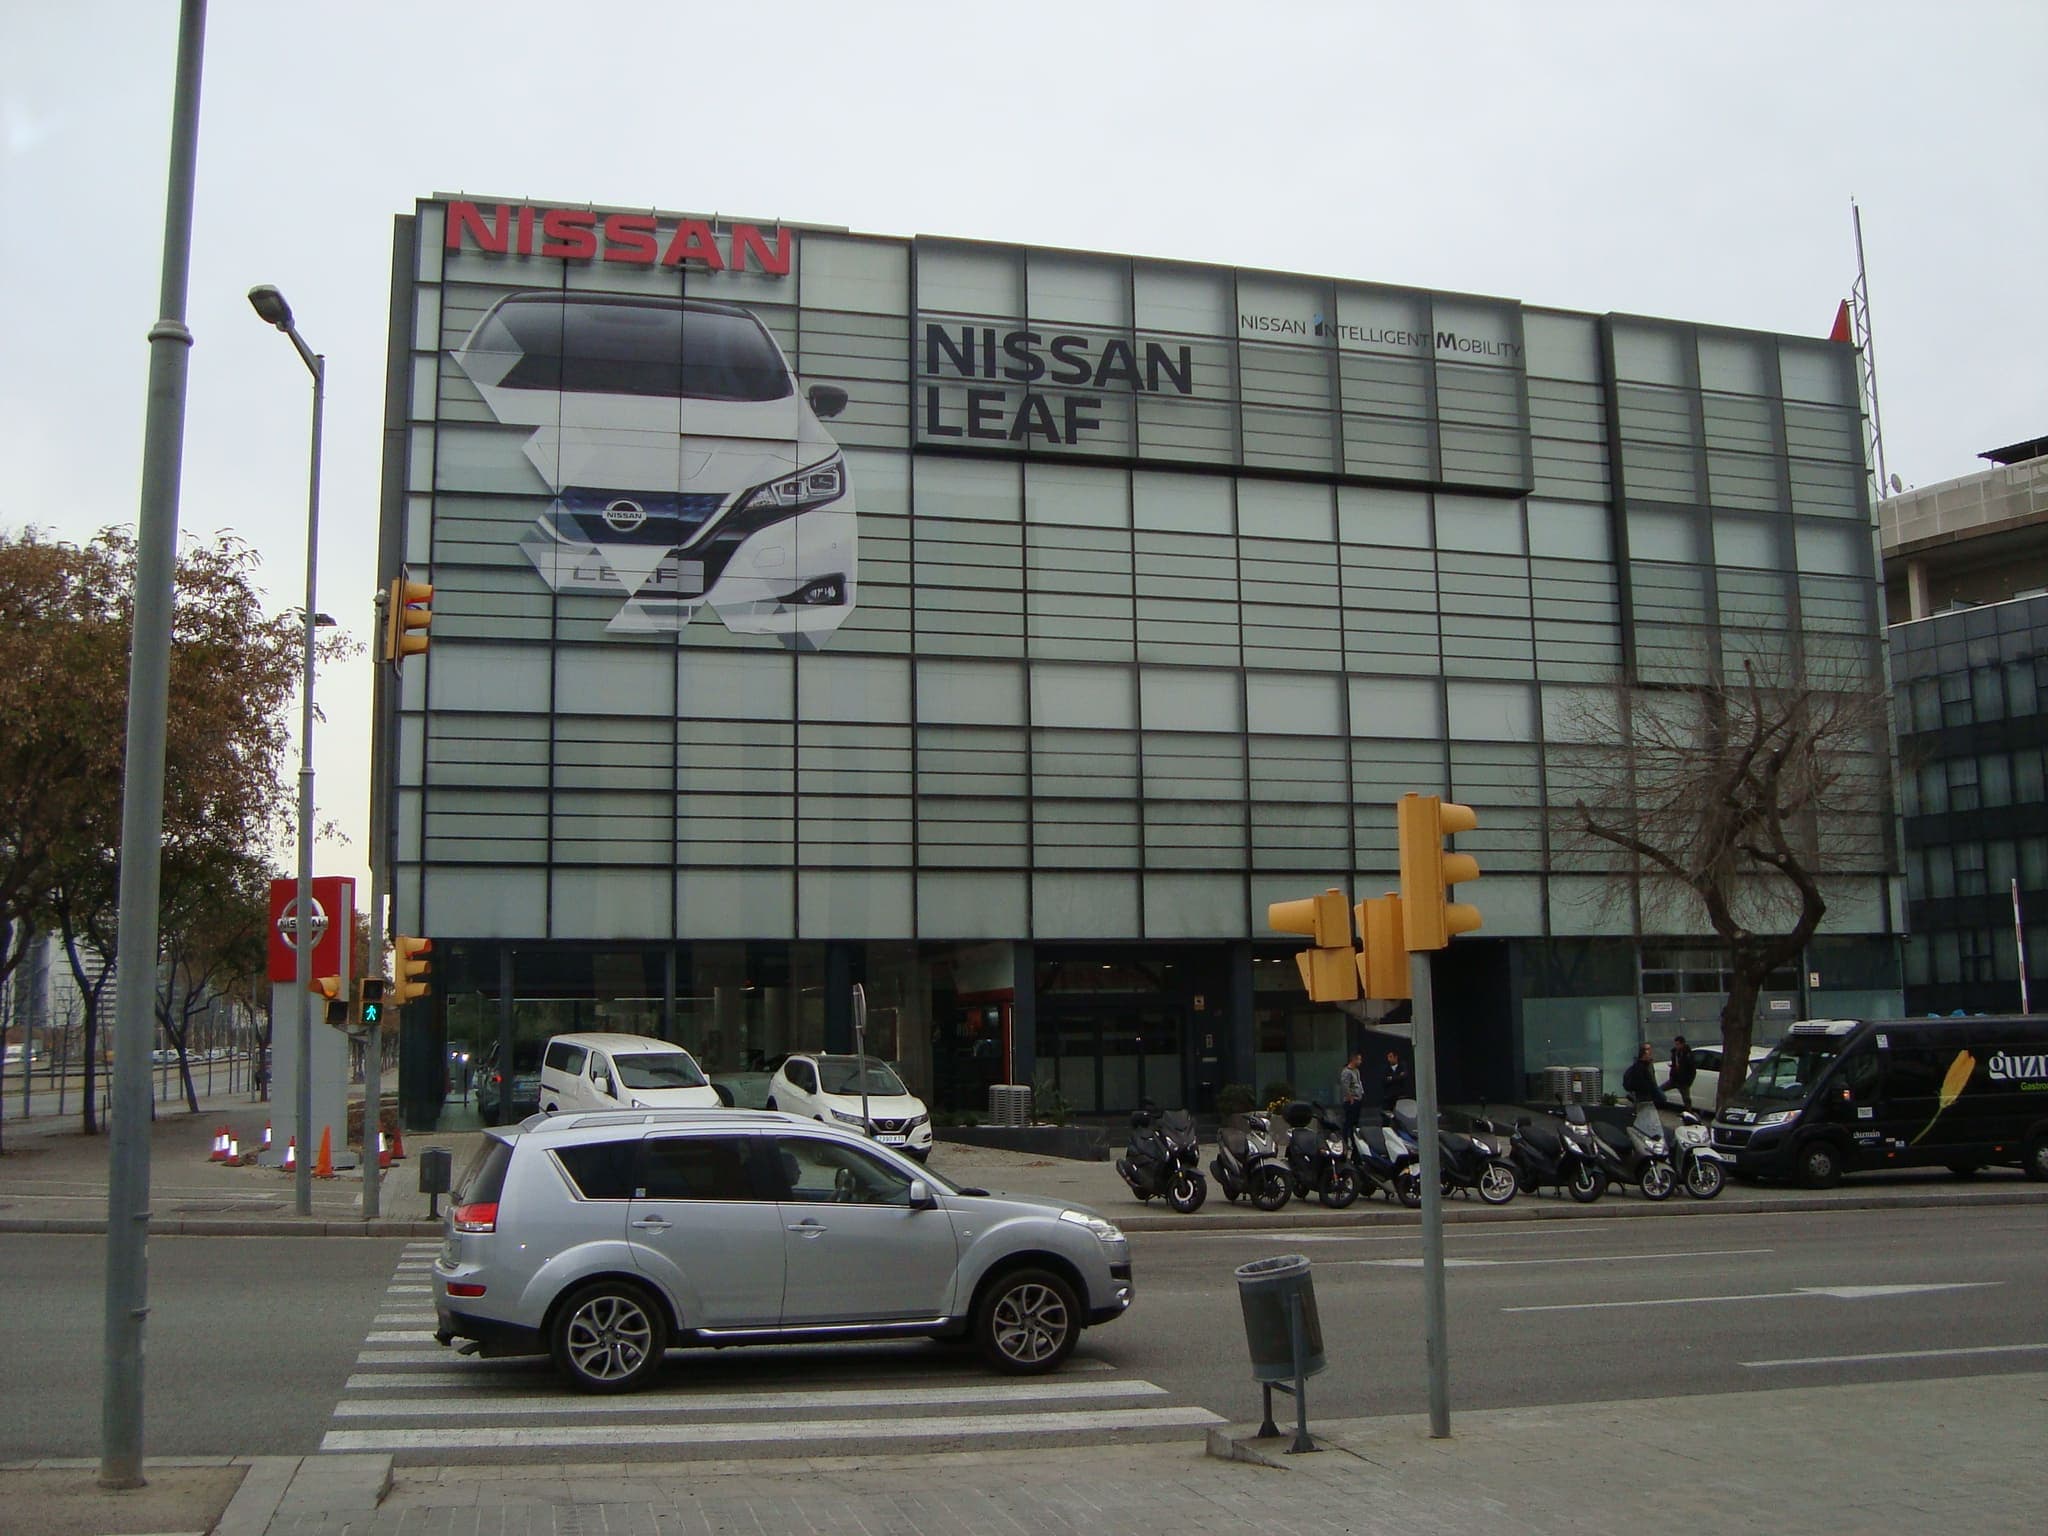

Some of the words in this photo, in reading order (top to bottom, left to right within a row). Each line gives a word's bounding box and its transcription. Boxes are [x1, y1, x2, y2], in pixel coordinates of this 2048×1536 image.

[446, 200, 792, 276] NISSAN
[1241, 314, 1307, 335] NISSAN
[1436, 331, 1520, 358] MOBILITY
[926, 323, 1192, 395] NISSAN
[927, 386, 1101, 445] LEAF
[606, 511, 642, 519] NISSAN
[573, 565, 678, 584] LEF
[280, 918, 322, 929] NISN
